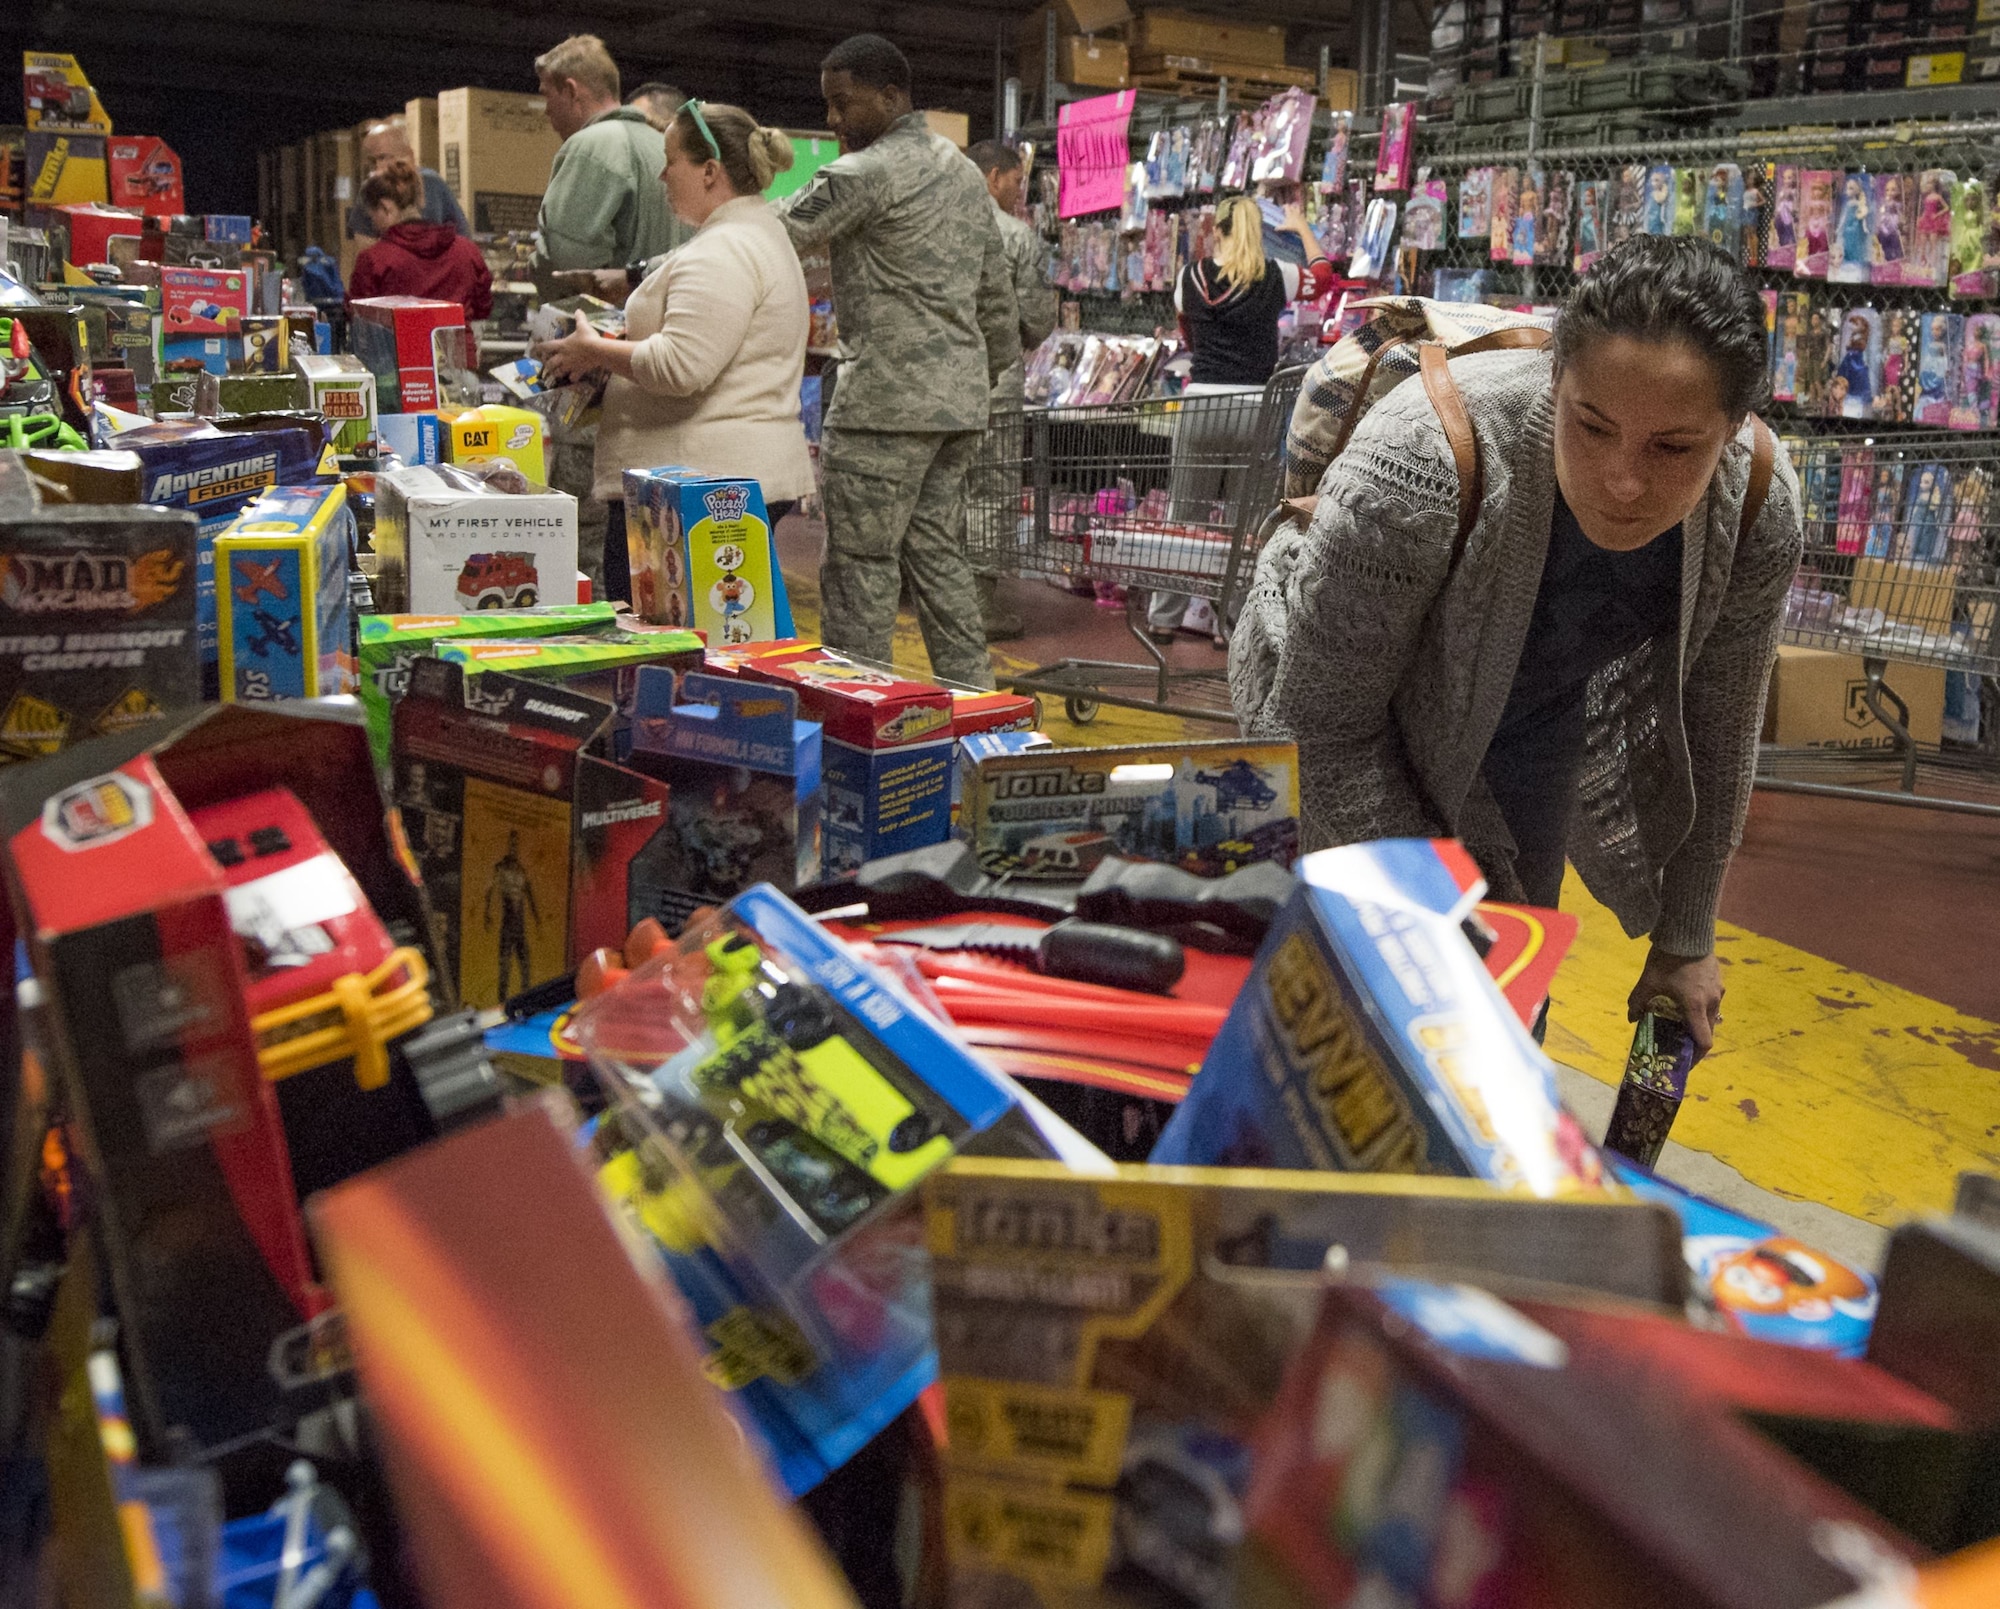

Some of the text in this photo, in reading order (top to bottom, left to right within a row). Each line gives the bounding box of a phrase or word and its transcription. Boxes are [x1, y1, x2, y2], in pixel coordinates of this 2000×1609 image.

[323, 404, 363, 417] WORLD
[463, 430, 490, 447] CAT
[150, 453, 277, 502] ADVENTURE
[197, 473, 269, 501] FORCE
[429, 518, 564, 528] MY FIRST VEHICLE
[713, 508, 742, 521] Head
[984, 767, 1106, 800] Tonka
[581, 800, 662, 829] MULTIVERSE
